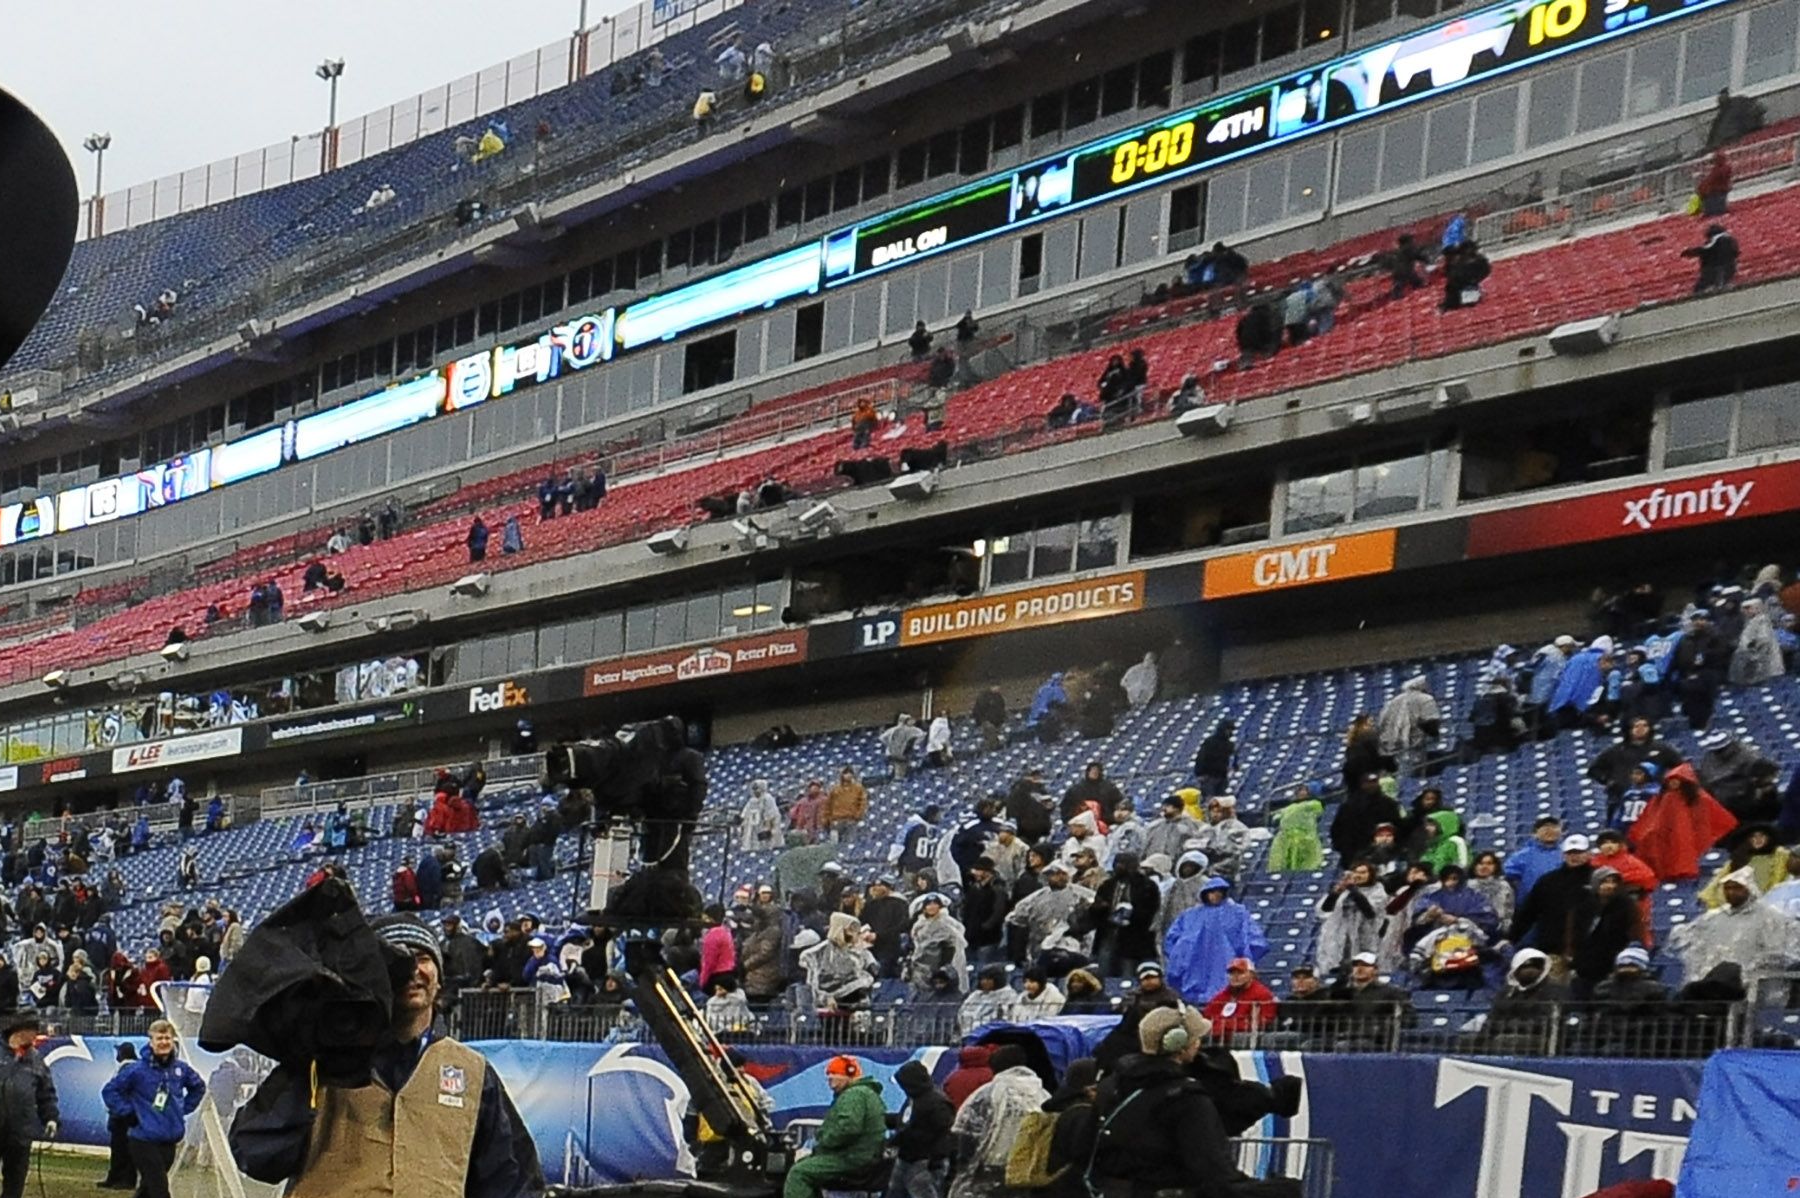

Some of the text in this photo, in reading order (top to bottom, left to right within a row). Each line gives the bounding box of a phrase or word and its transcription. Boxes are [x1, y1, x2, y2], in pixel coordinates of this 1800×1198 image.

[1206, 106, 1265, 143] 4TH
[1111, 121, 1195, 183] 0:00
[872, 226, 948, 266] BALL ON
[1622, 480, 1755, 529] xfinity
[1255, 544, 1336, 587] CMT
[863, 582, 1134, 646] LP BUILDING PRODUCTS
[469, 681, 528, 713] FedEx
